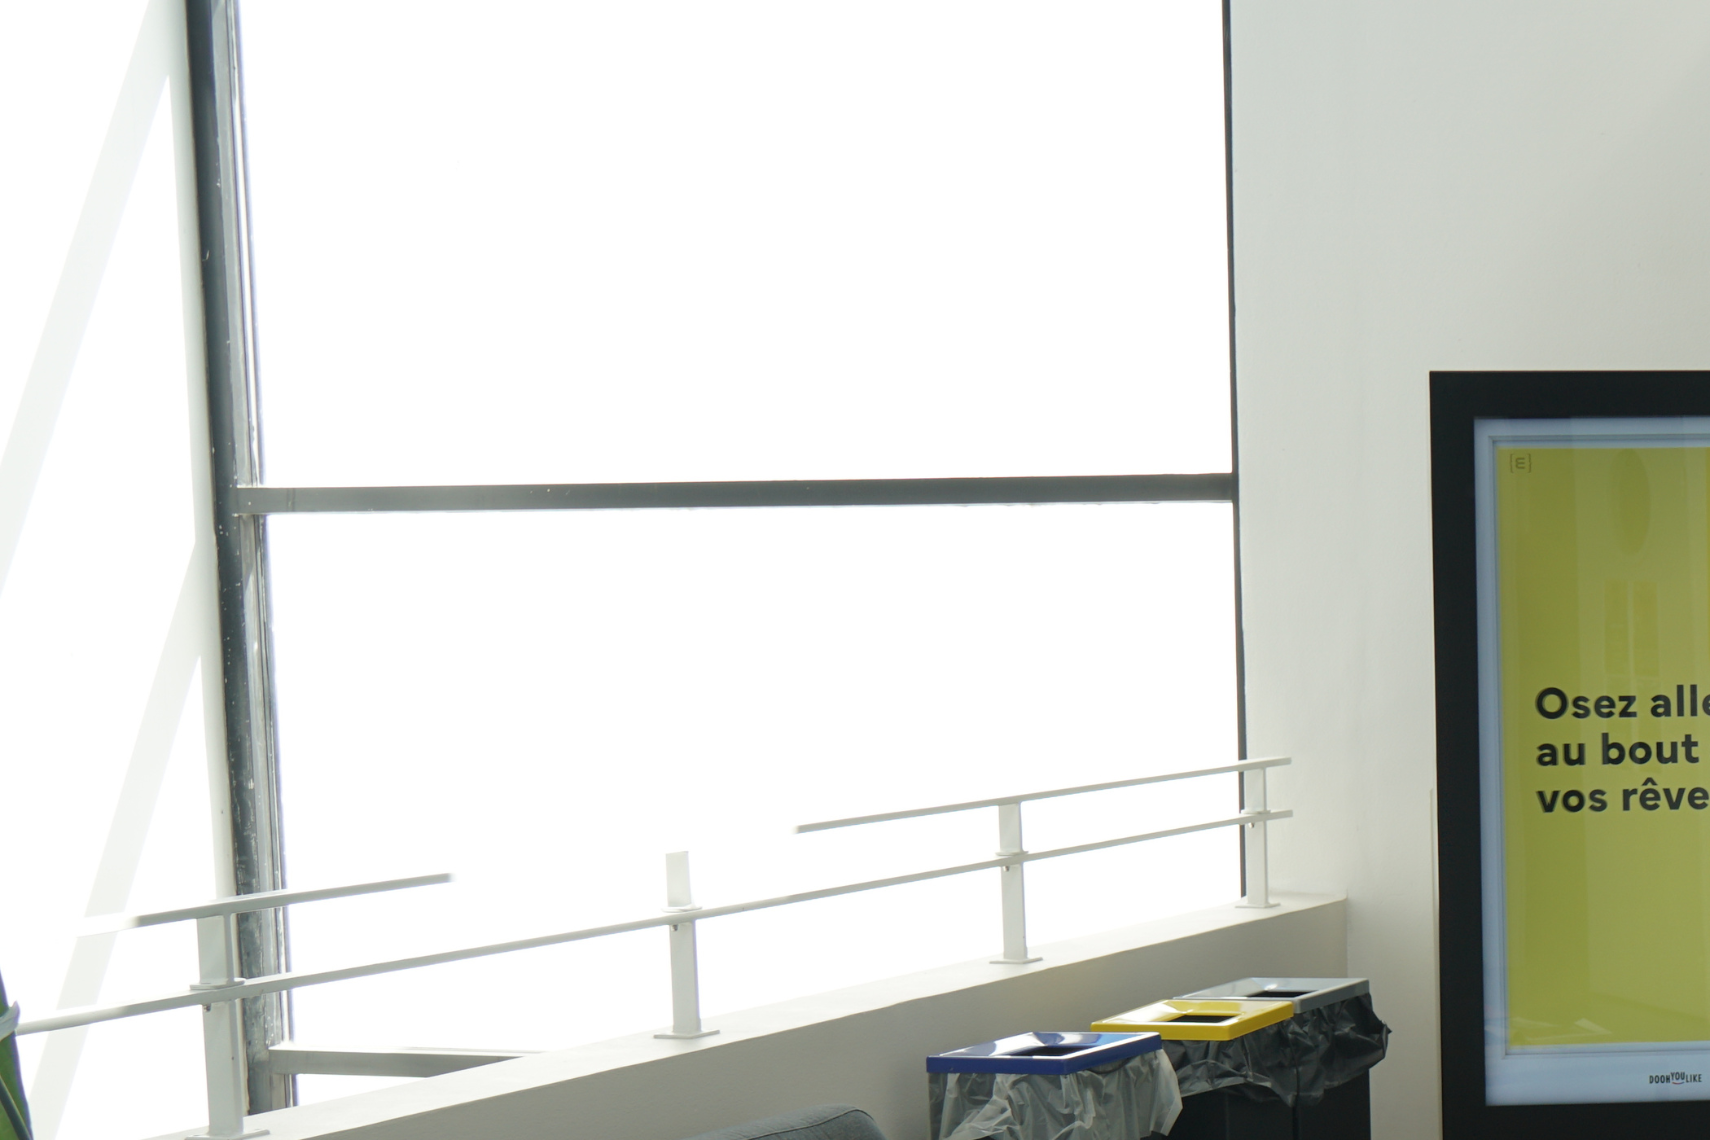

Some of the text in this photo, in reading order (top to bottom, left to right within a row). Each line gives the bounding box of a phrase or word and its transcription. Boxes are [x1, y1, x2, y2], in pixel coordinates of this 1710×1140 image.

[1534, 686, 1637, 720] Osez
[1536, 742, 1587, 767] au
[1601, 732, 1700, 766] bout
[1535, 788, 1608, 813] vos
